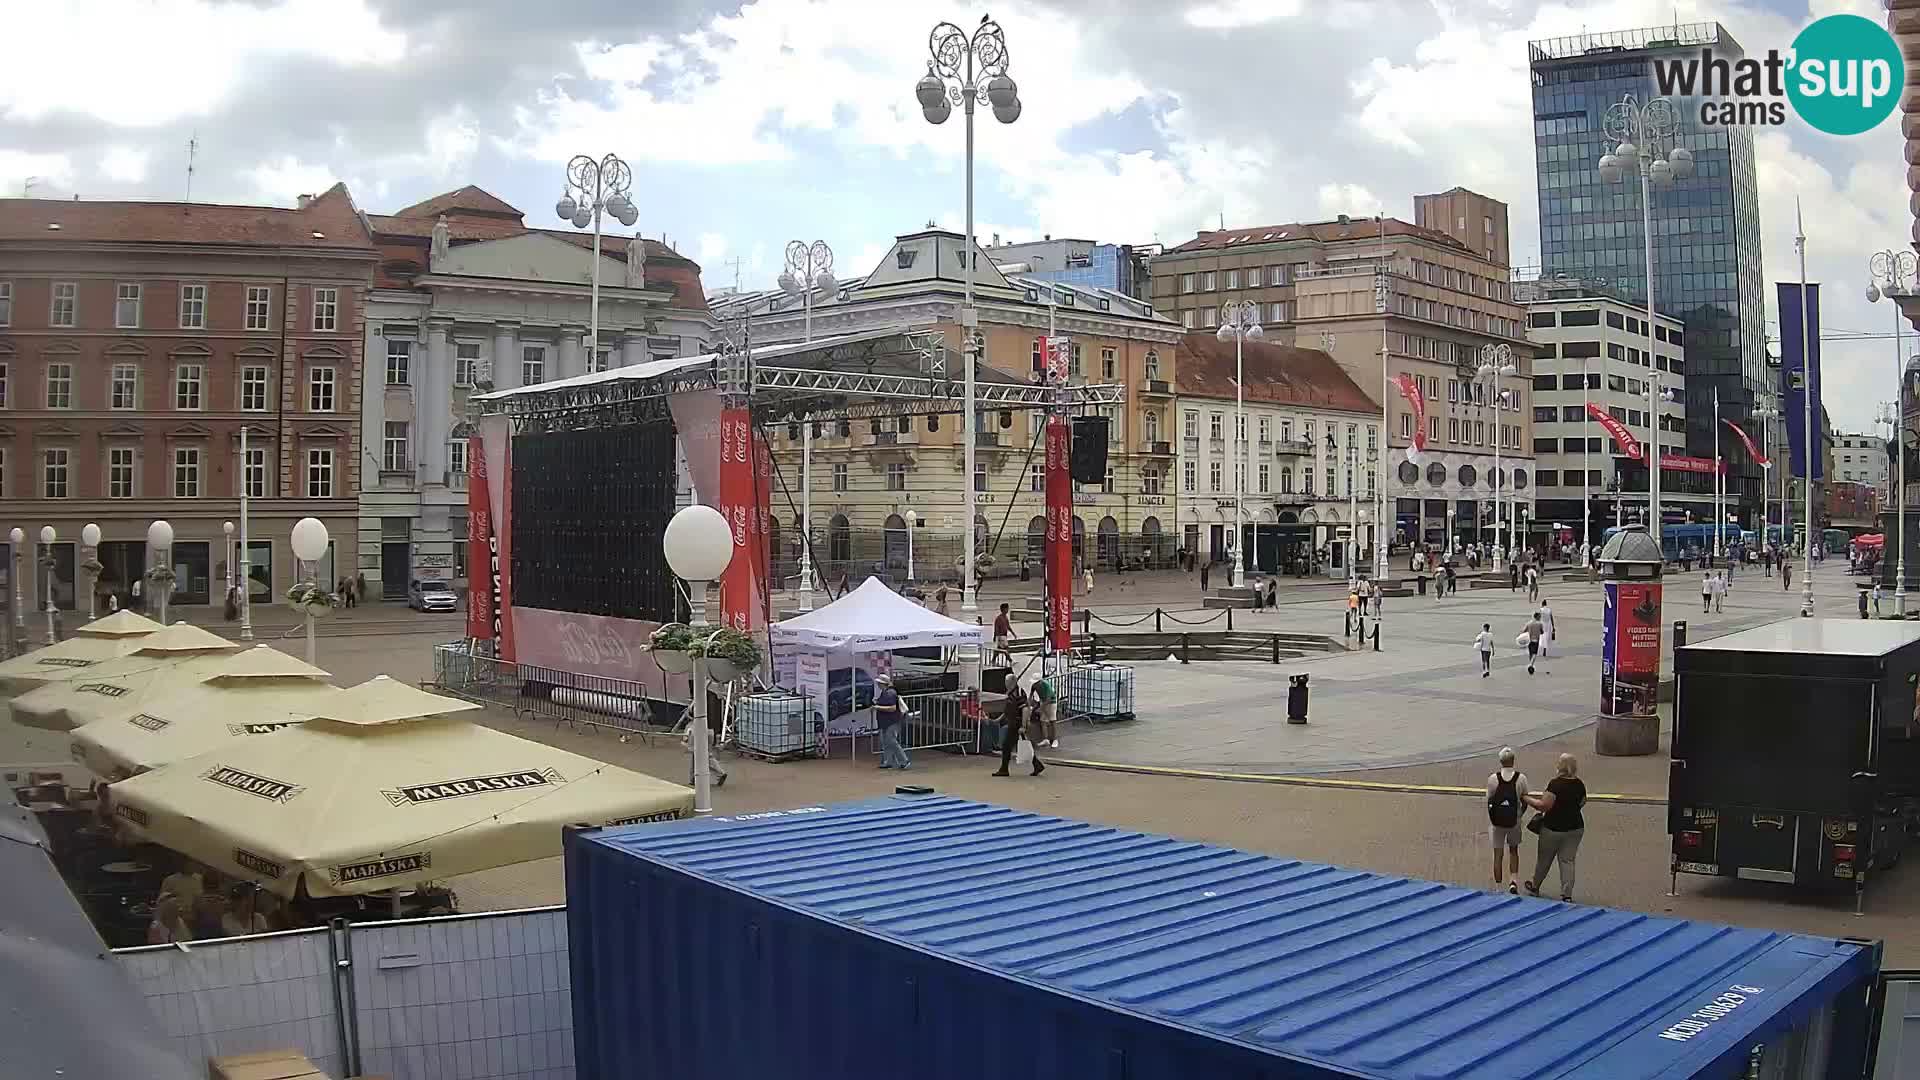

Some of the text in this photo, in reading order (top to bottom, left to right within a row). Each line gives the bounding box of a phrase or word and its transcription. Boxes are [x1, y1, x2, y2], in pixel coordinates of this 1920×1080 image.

[216, 768, 286, 799] MARASKA
[412, 773, 542, 800] MARASKA
[343, 856, 418, 881] MARASKA
[1691, 992, 1747, 1021] 300629
